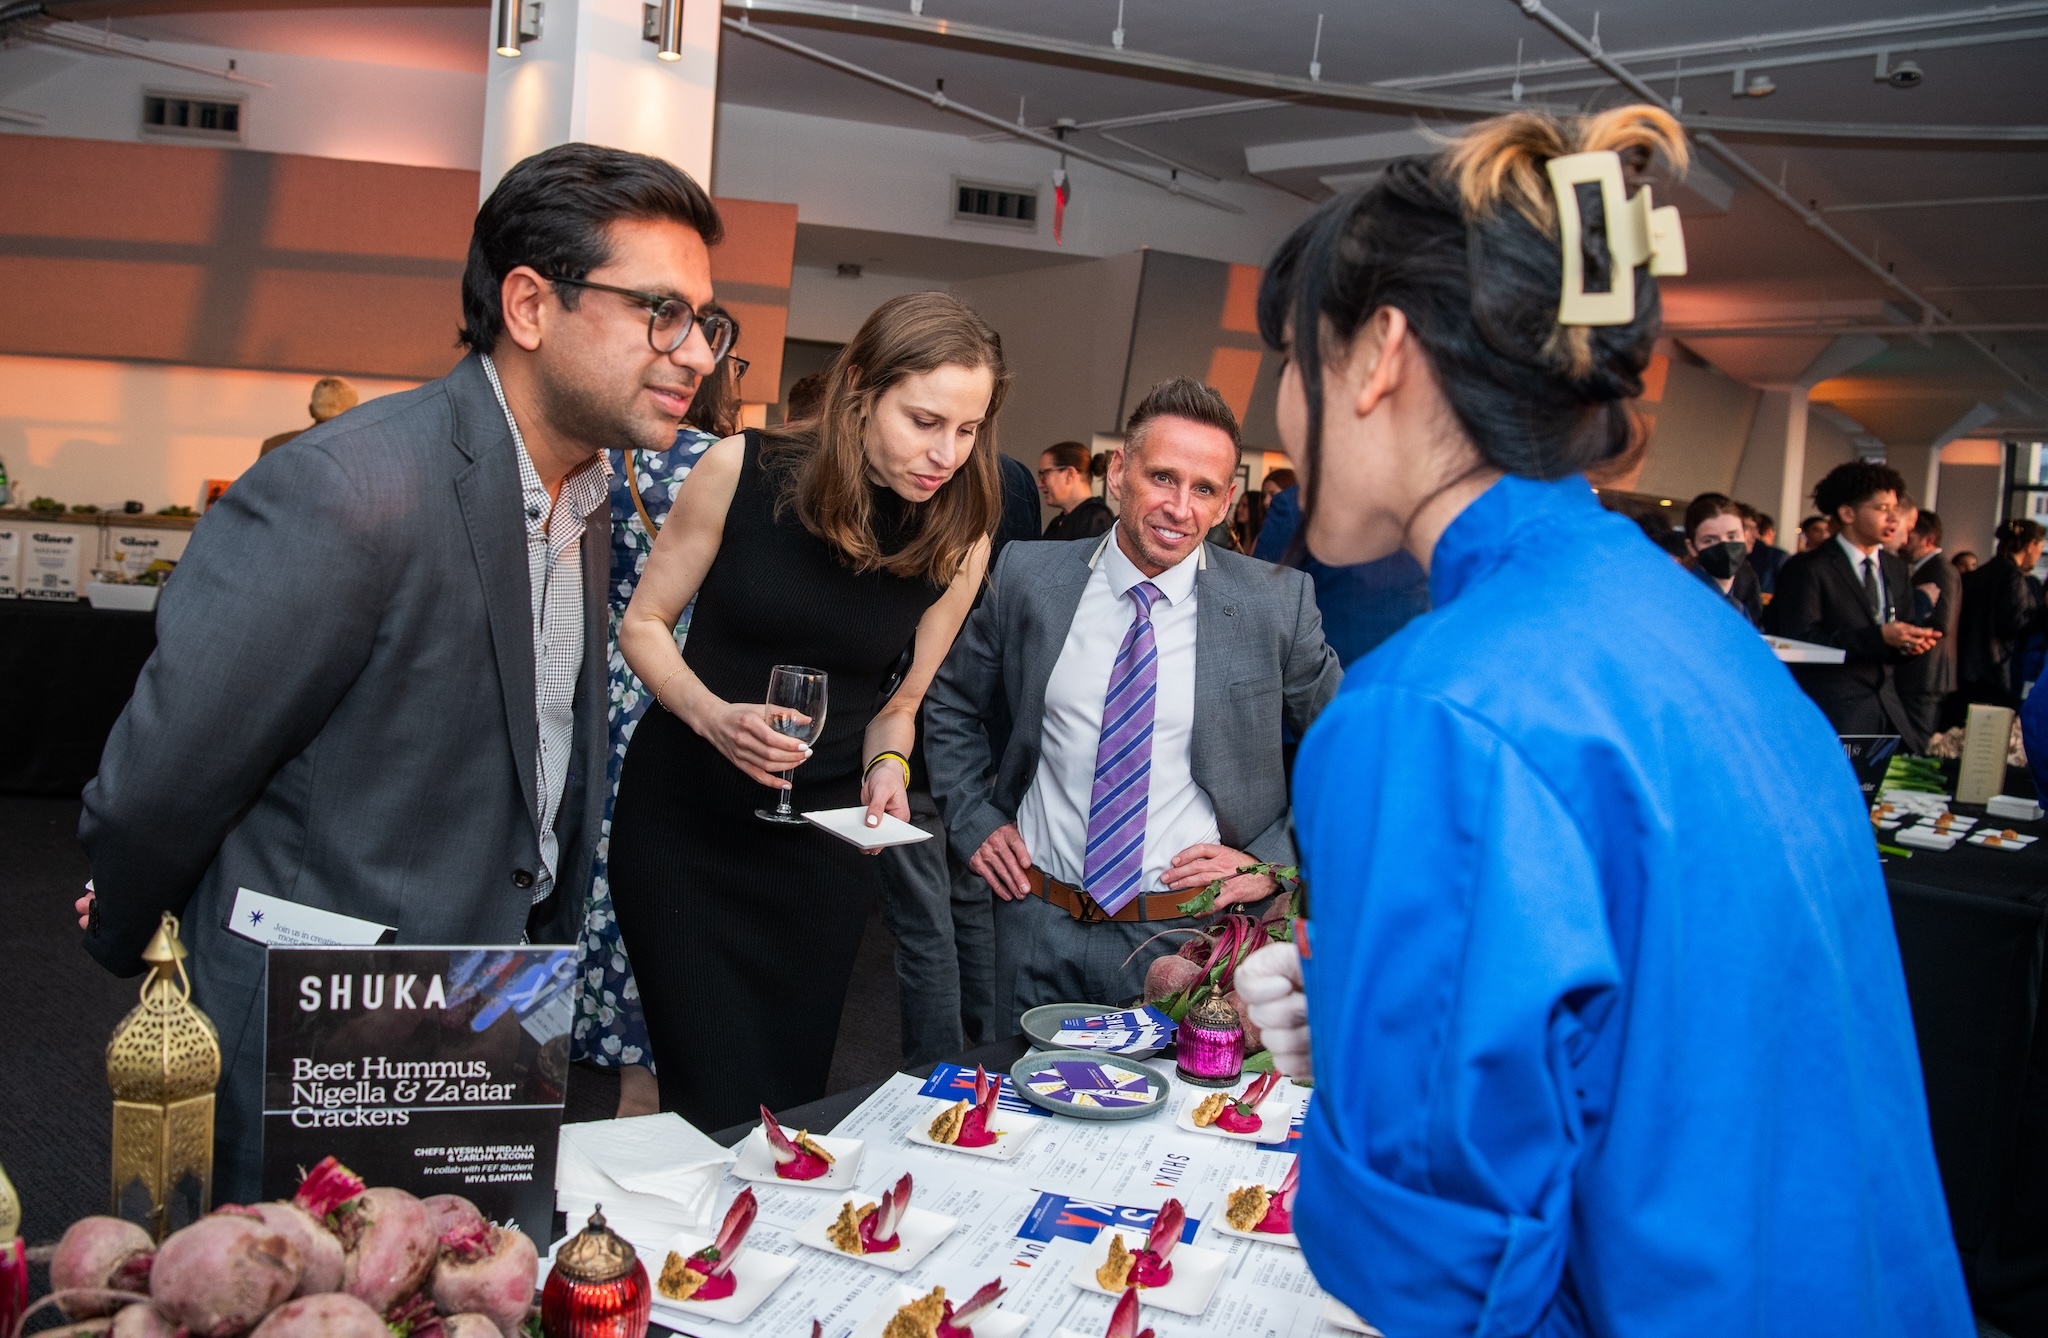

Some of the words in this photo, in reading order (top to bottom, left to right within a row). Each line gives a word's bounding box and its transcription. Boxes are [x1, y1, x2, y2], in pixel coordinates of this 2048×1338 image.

[274, 923, 290, 934] Join
[292, 929, 300, 937] us
[302, 930, 309, 939] in
[278, 934, 299, 945] more
[300, 973, 447, 1012] SHUKA
[292, 1057, 356, 1081] Beet
[361, 1056, 492, 1080] Hummus,
[291, 1081, 387, 1109] Nigella
[393, 1079, 421, 1103] &
[425, 1079, 517, 1102] Za'atar
[291, 1106, 410, 1128] Crackers
[414, 1147, 446, 1157] CHEFS
[446, 1146, 484, 1155] AYESHA
[486, 1144, 535, 1154] NURDJAJA
[447, 1154, 455, 1162] &
[457, 1154, 494, 1162] CARLHA
[496, 1152, 534, 1160] AZCONA
[423, 1166, 432, 1175] in
[433, 1164, 461, 1174] collab
[462, 1164, 480, 1173] with
[481, 1163, 499, 1172] FEF
[500, 1163, 534, 1171] Student
[465, 1174, 486, 1183] MYA
[488, 1172, 532, 1182] SANTANA
[1151, 1153, 1190, 1188] SHUKA
[1010, 1244, 1045, 1267] UKA
